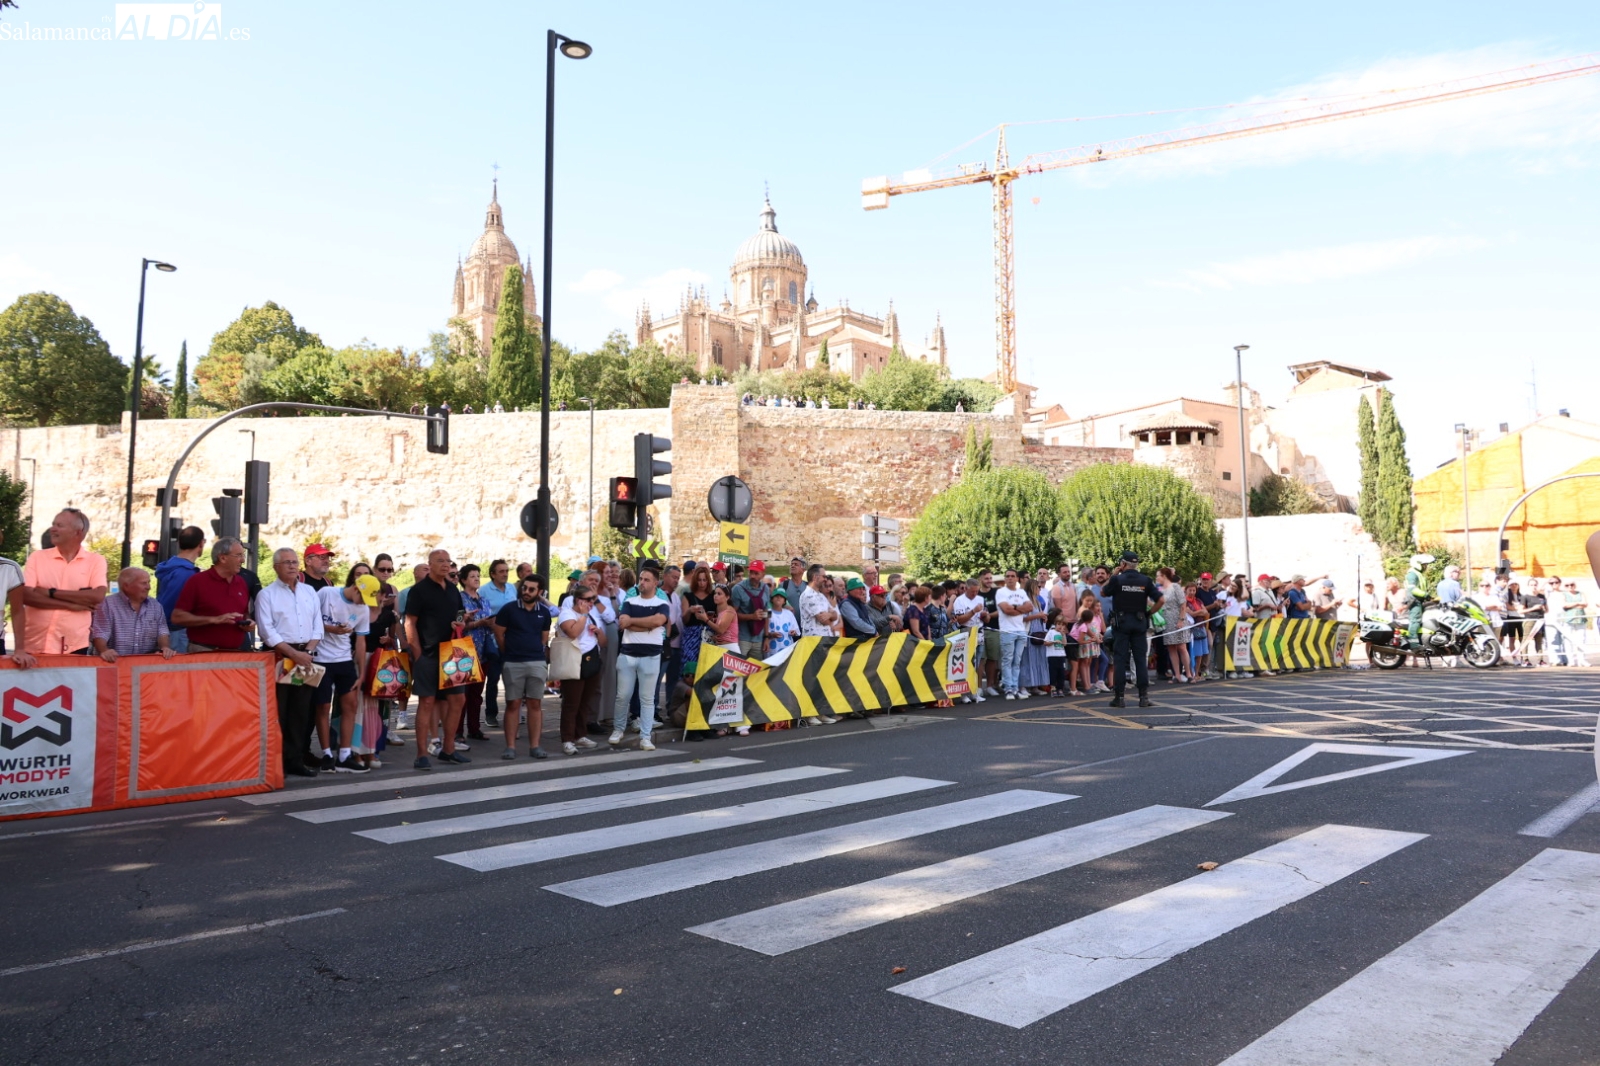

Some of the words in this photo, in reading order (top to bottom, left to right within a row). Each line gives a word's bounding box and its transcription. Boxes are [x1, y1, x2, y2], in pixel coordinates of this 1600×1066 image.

[0, 754, 71, 772] WÜRTH
[0, 767, 71, 785] MODYF
[0, 786, 70, 801] WORKWEAR
